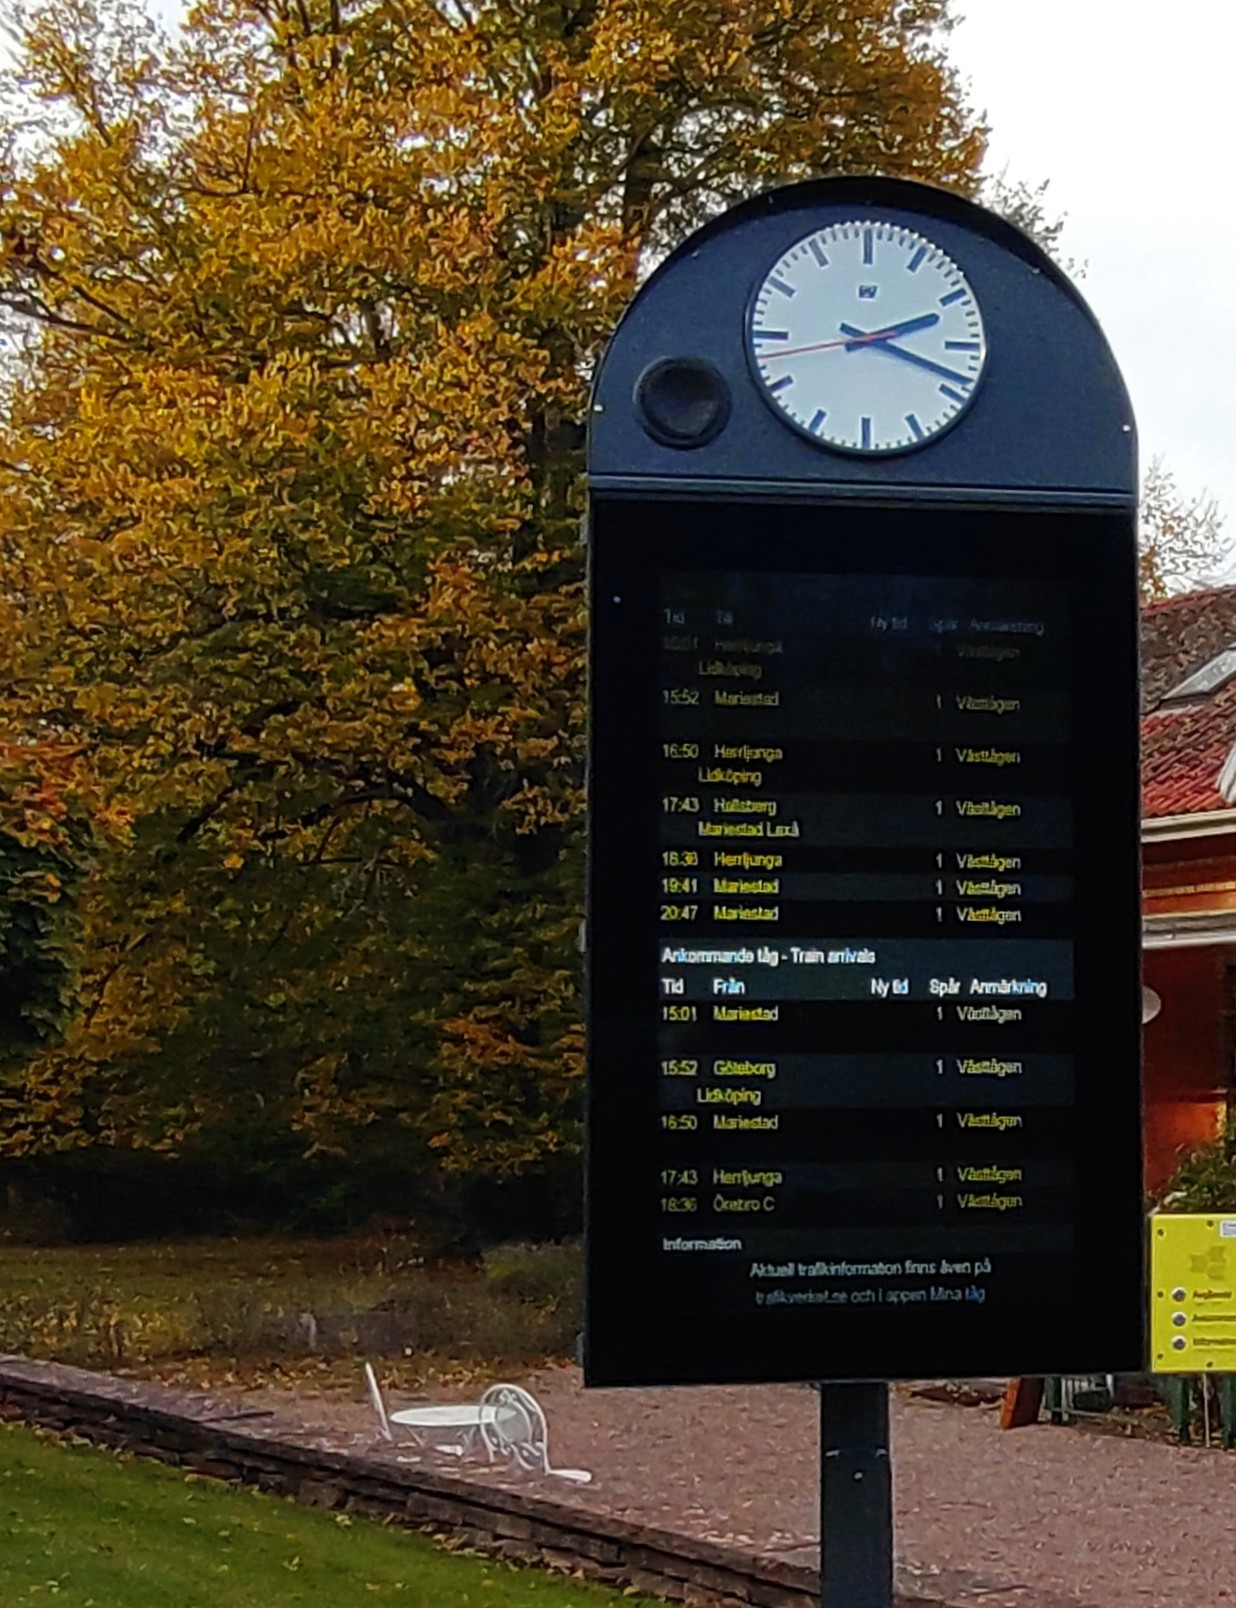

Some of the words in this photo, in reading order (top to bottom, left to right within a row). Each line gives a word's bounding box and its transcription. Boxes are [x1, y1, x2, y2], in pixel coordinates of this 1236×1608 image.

[661, 977, 686, 995] Tid
[713, 977, 746, 995] Från
[870, 977, 889, 998] Ny
[929, 976, 962, 998] Spår
[969, 977, 1048, 999] Anmärkning
[763, 1195, 777, 1213] C
[662, 1237, 744, 1251] Information
